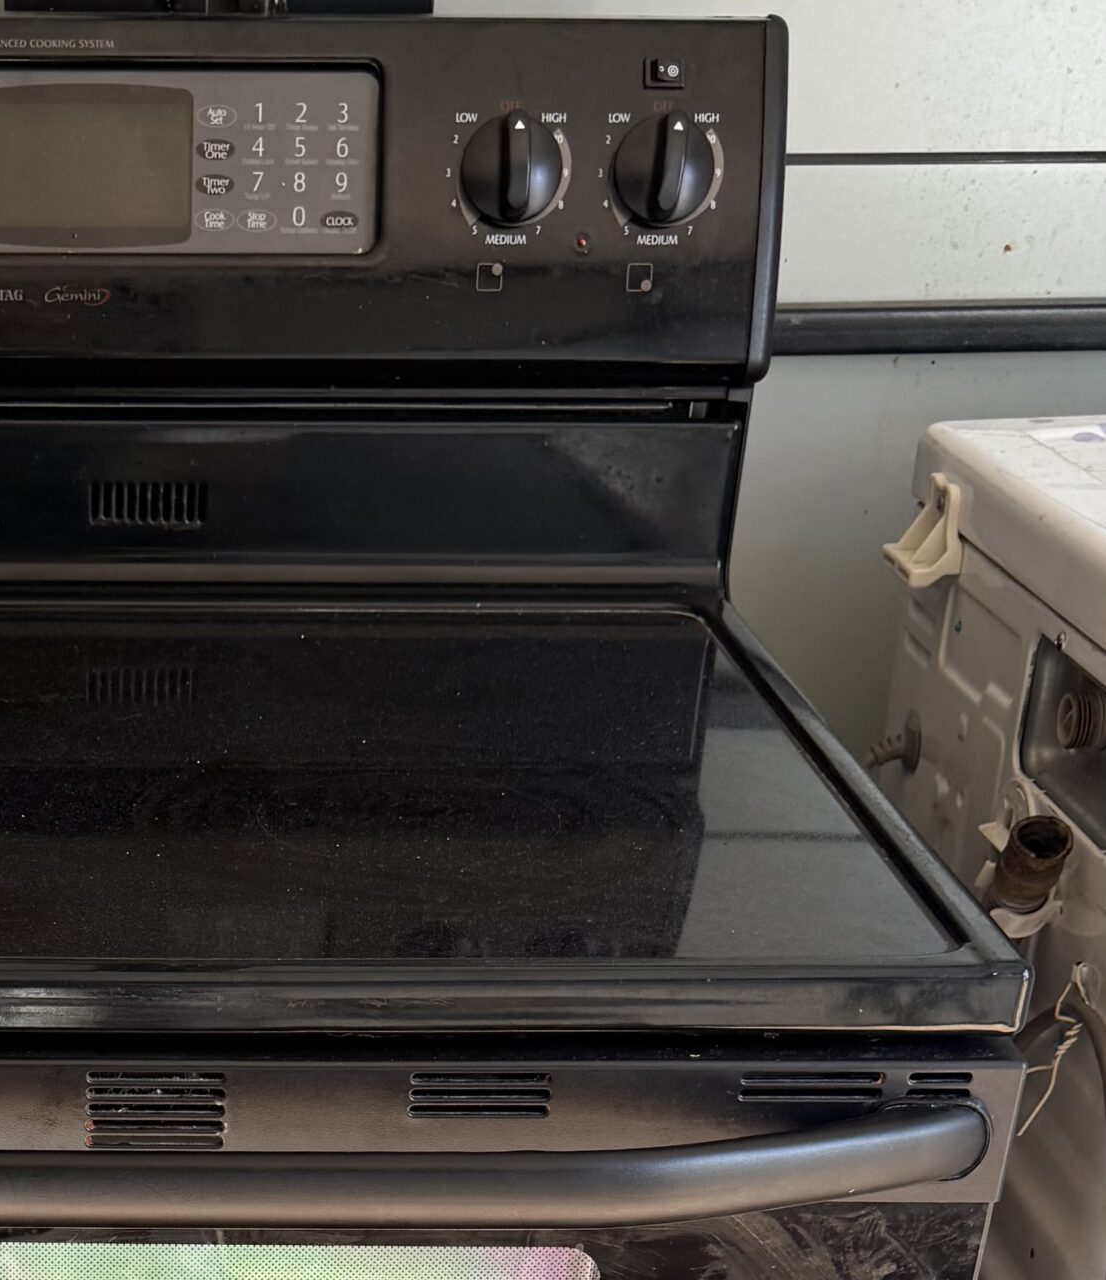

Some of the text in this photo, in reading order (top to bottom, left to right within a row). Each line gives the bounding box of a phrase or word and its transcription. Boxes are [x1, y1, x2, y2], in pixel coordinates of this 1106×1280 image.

[29, 39, 76, 49] COOKING
[78, 39, 115, 49] SYSTEM
[207, 108, 227, 117] Auto
[255, 102, 263, 122] 1
[295, 102, 307, 123] 2
[337, 102, 349, 123] 3
[455, 112, 478, 123] LOW
[541, 112, 567, 123] HIGH
[210, 116, 224, 125] Set
[608, 113, 631, 123] LOW
[694, 113, 720, 123] HIGH
[203, 141, 230, 151] Timer
[252, 136, 265, 157] 4
[294, 136, 306, 157] 5
[336, 137, 349, 158] 6
[205, 150, 228, 160] One
[202, 176, 230, 186] Timer
[252, 171, 264, 192] 7
[293, 171, 306, 193] 8
[335, 171, 348, 193] 9
[207, 185, 226, 195] Two
[204, 211, 226, 221] Cook
[247, 211, 267, 222] Stop
[292, 206, 306, 227] 0
[326, 216, 354, 226] CLOCK
[205, 219, 226, 228] Time
[246, 219, 267, 229] Time
[485, 234, 527, 245] MEDIUM
[637, 234, 678, 245] MEDIUM
[45, 286, 106, 304] Gemini
